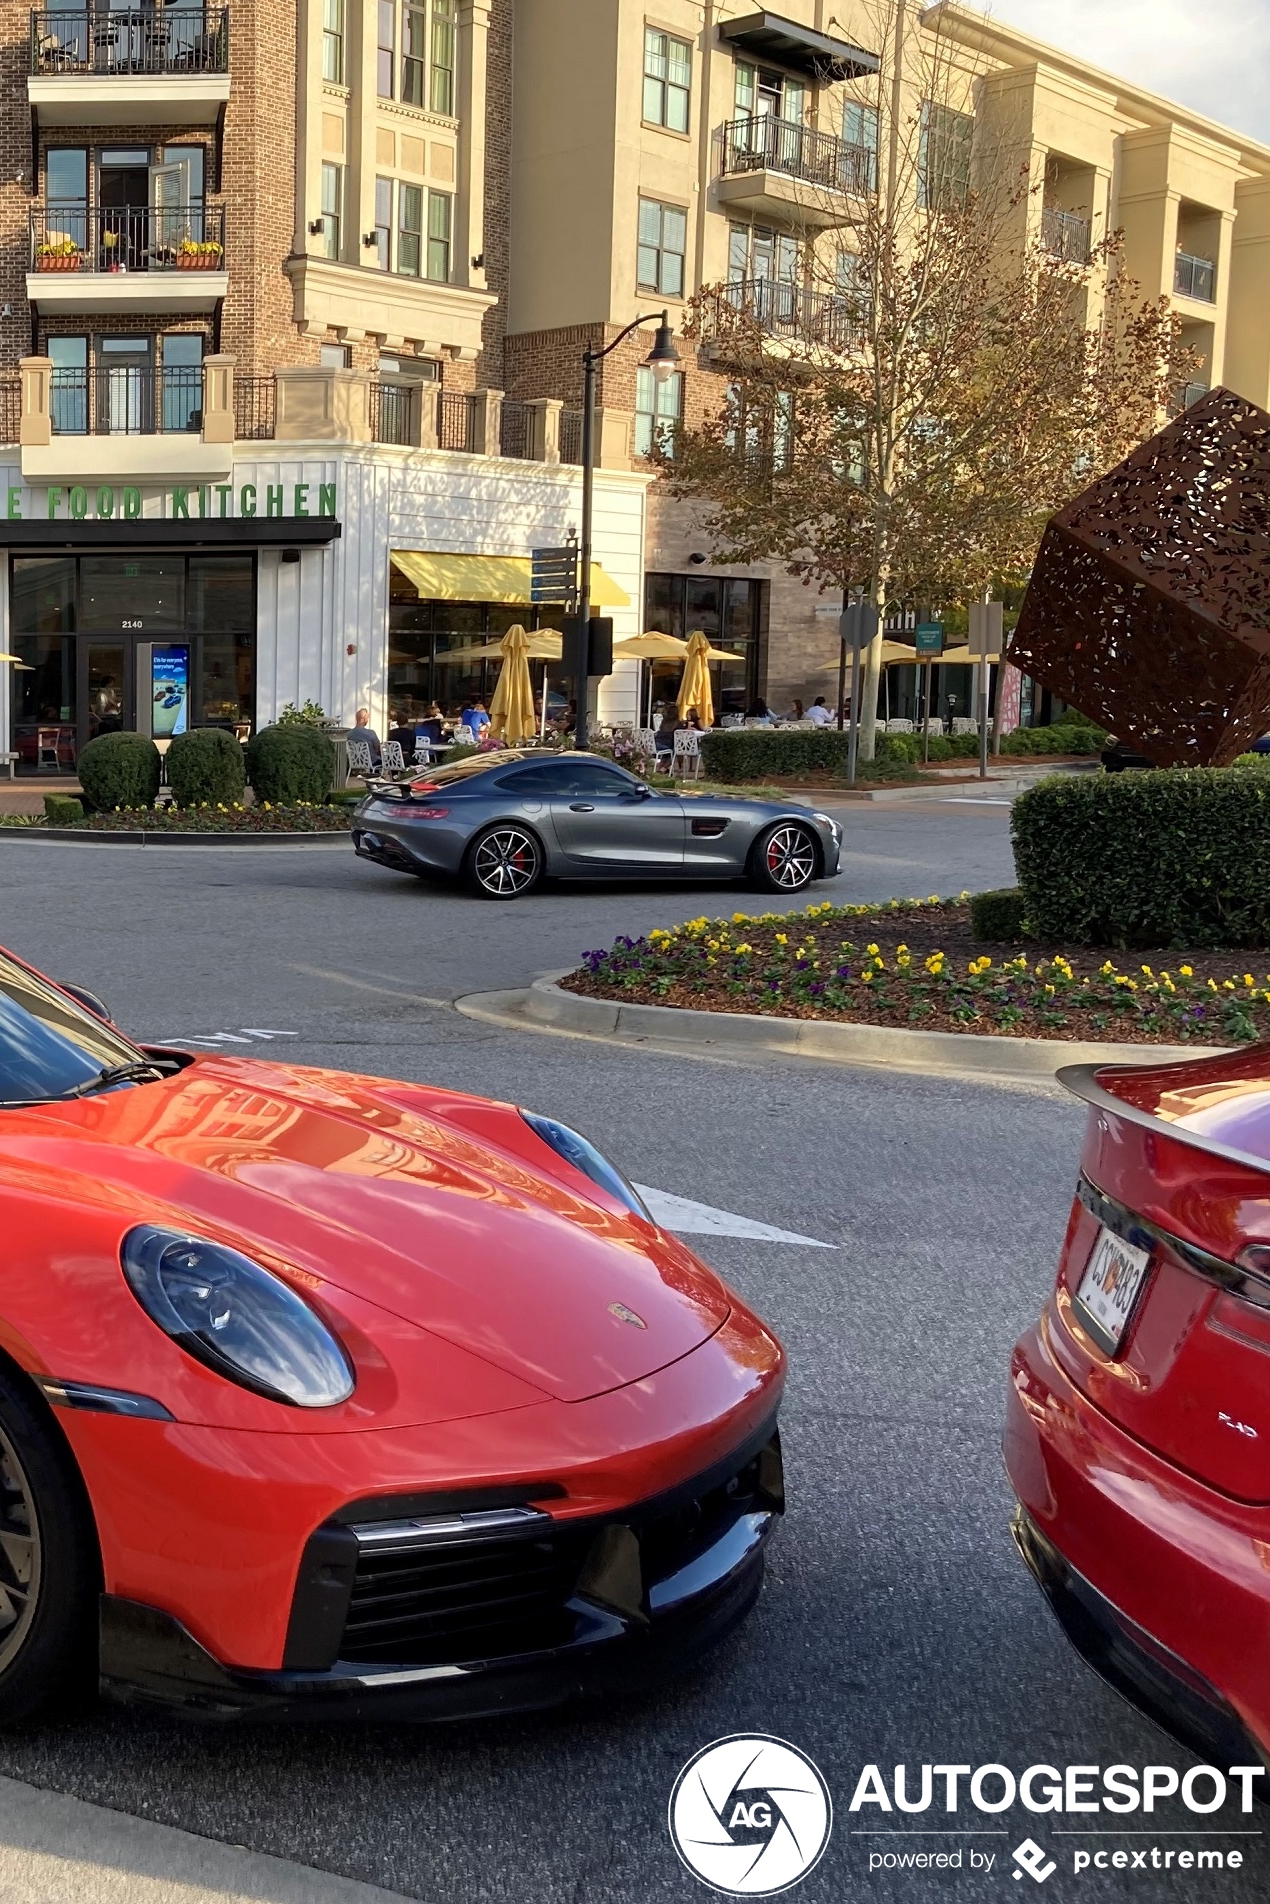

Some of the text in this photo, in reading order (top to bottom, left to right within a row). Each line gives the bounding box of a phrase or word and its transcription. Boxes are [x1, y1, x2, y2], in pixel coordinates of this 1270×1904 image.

[46, 485, 142, 520] FOOD
[172, 483, 337, 519] KITCHEN
[121, 620, 143, 629] 2140
